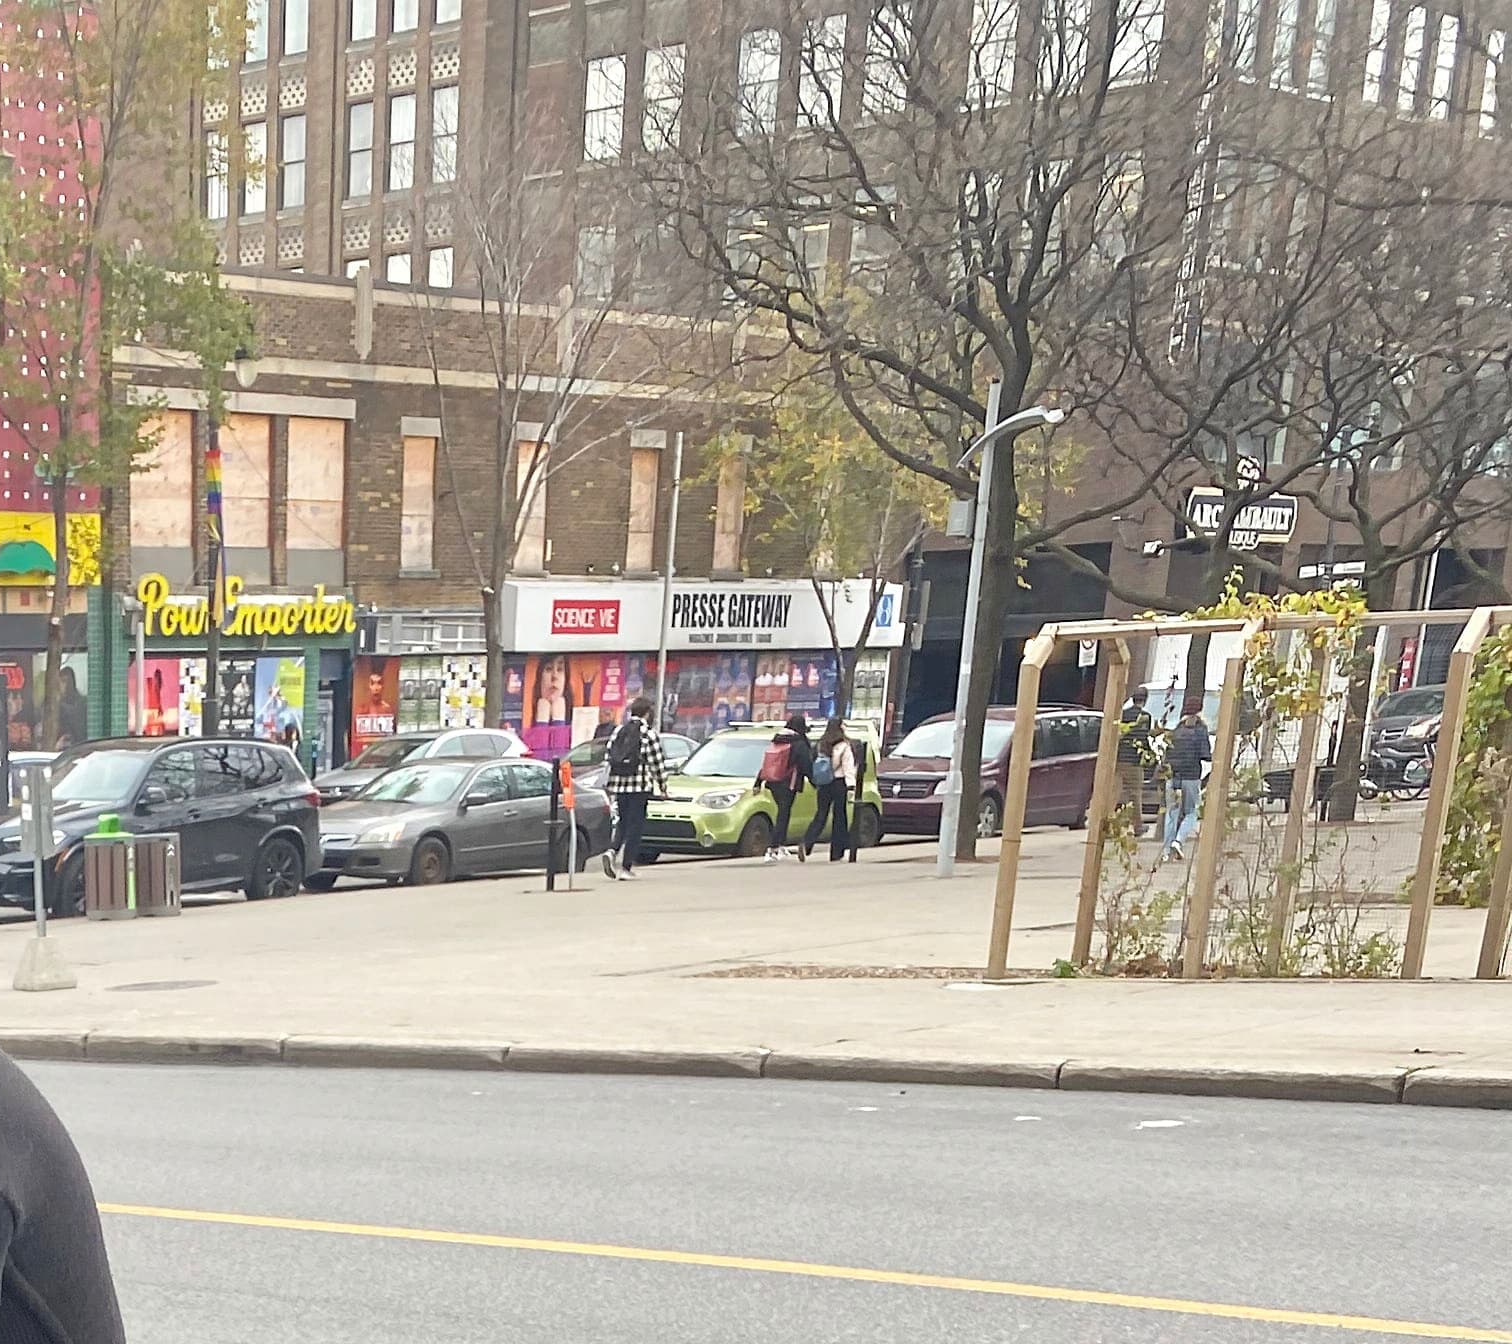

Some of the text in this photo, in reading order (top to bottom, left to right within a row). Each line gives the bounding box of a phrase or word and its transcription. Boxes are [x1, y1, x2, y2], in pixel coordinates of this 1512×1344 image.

[554, 607, 617, 628] SCIENCE VIE
[671, 593, 792, 629] PRESSE GATEWAY
